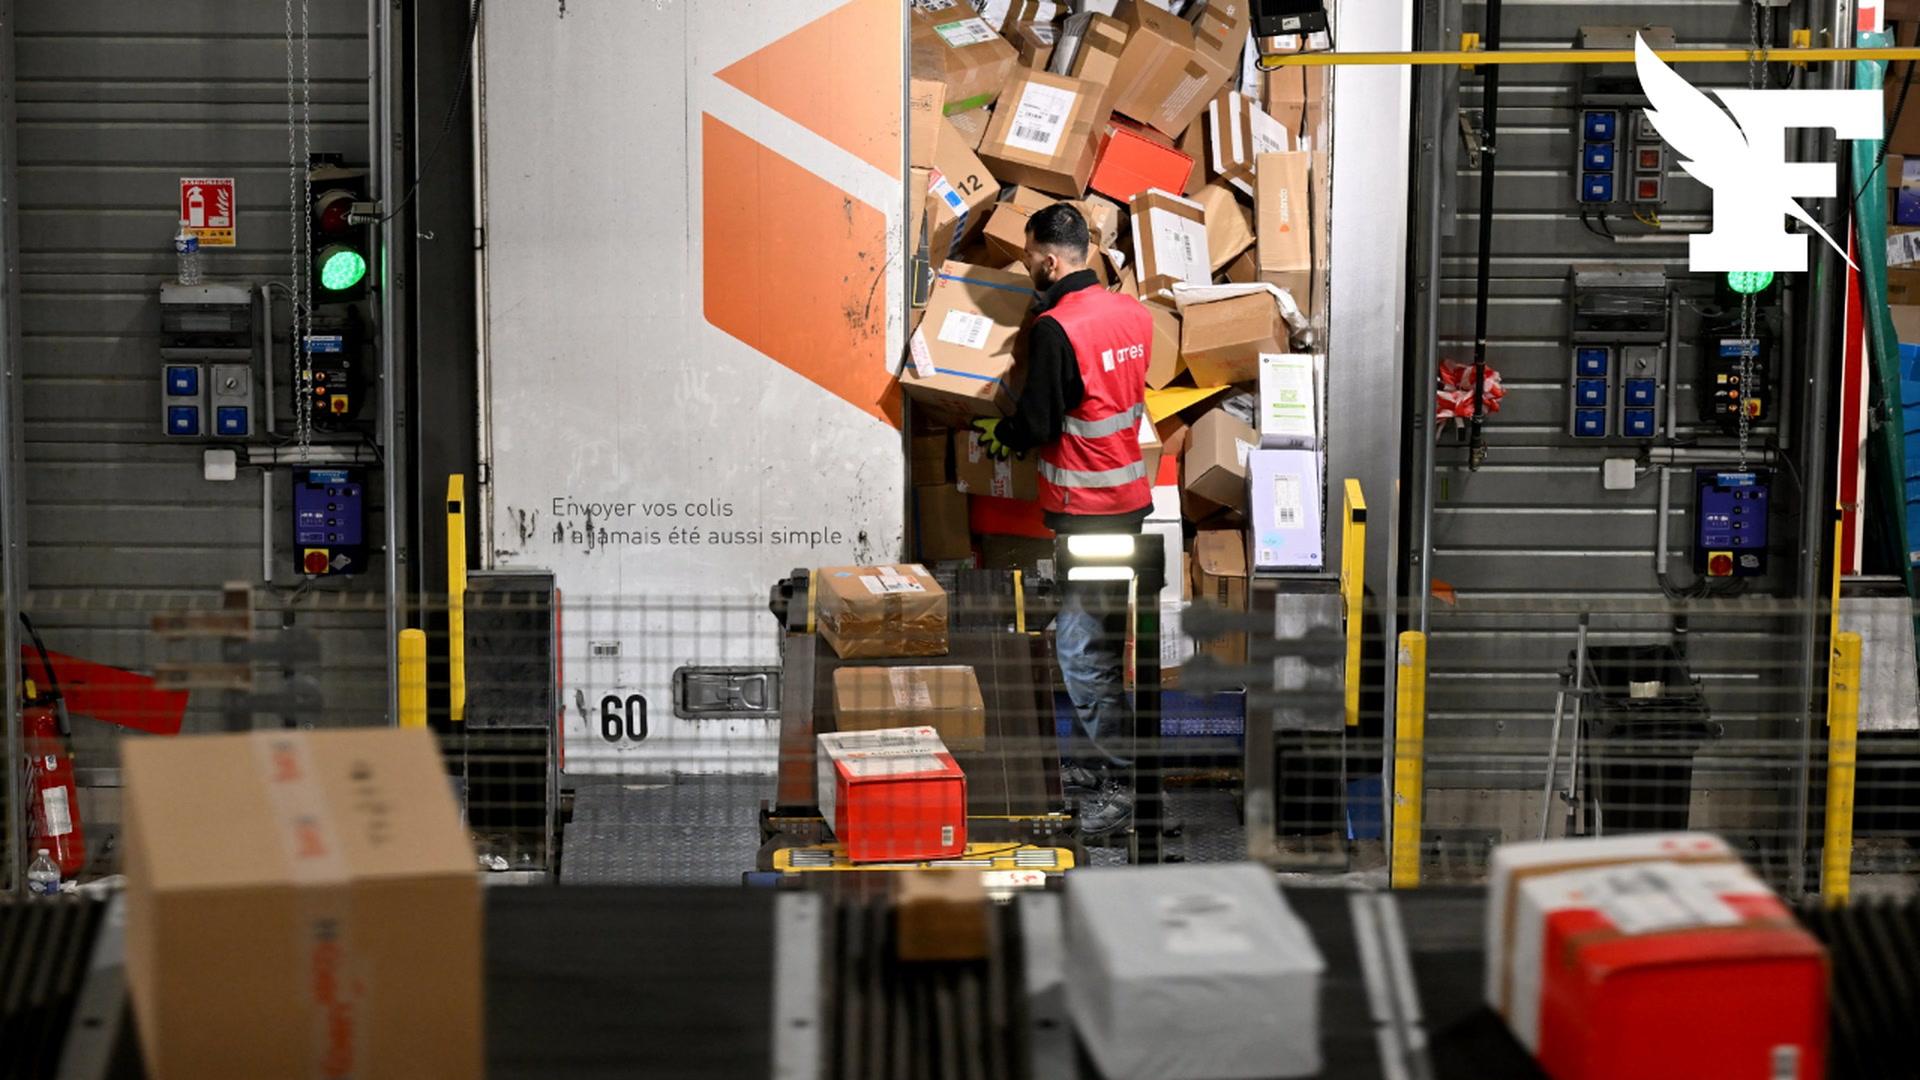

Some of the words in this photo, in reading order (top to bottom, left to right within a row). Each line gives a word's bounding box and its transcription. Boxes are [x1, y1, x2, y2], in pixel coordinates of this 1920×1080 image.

[957, 174, 983, 196] 12
[1279, 187, 1290, 225] zalando
[552, 497, 636, 521] Envoyer
[642, 502, 678, 517] vos
[684, 497, 734, 517] colis
[586, 526, 661, 550] jamais
[668, 526, 701, 545] été
[707, 526, 763, 545] aussi
[770, 526, 843, 550] simple
[601, 693, 648, 743] 60
